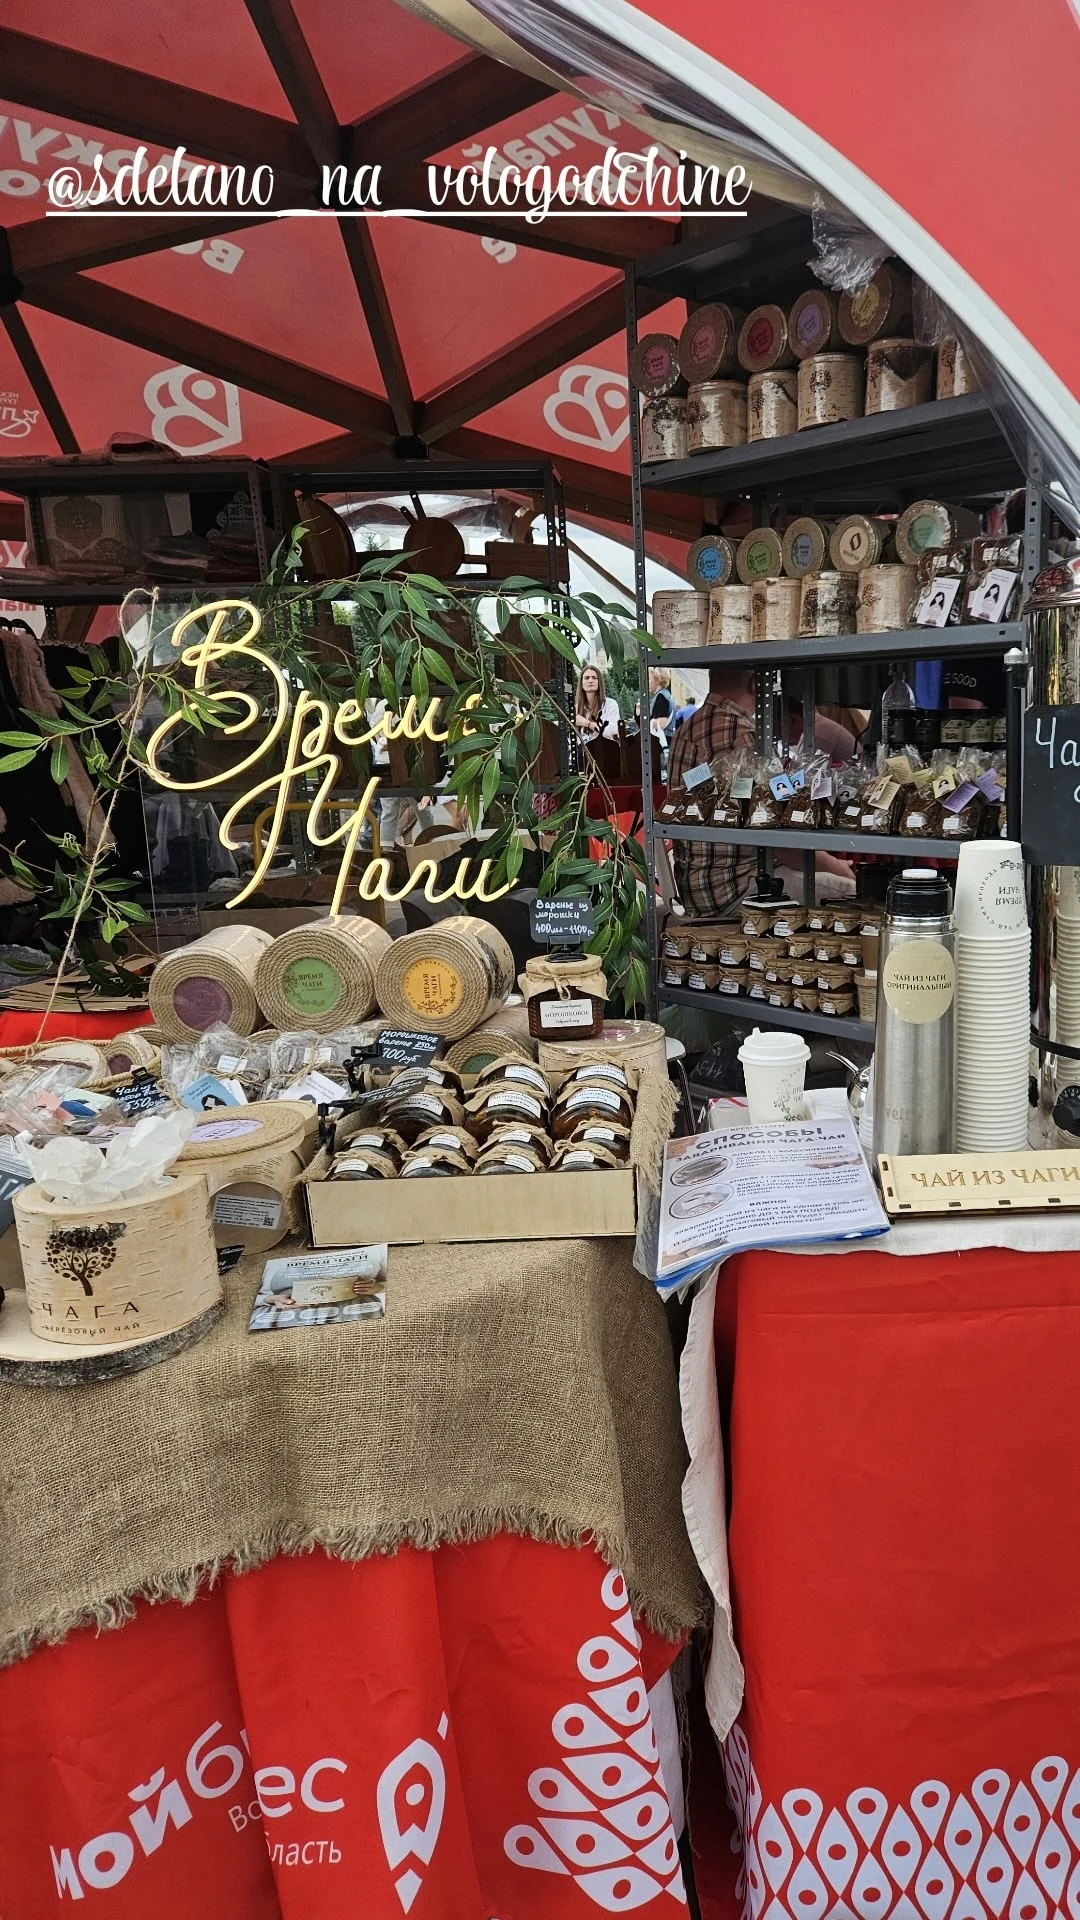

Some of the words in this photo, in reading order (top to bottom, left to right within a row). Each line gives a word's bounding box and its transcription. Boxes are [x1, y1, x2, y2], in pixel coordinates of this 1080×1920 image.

[893, 973, 910, 982] ЧАЙ
[925, 973, 947, 982] ЧАГИ
[695, 1128, 823, 1150] СПОСОБЫ
[674, 1139, 775, 1163] ЗАВАРИВАНИЯ
[778, 1134, 846, 1144] ЧАГА-ЧАЯ
[911, 1169, 966, 1188] ЧАЙ
[971, 1170, 1006, 1186] ИЗ
[1011, 1166, 1080, 1184] ЧАГИ
[749, 1199, 787, 1207] ВАЖНО!
[41, 1301, 140, 1319] ЧАГА
[114, 1322, 140, 1332] ЧАЙ
